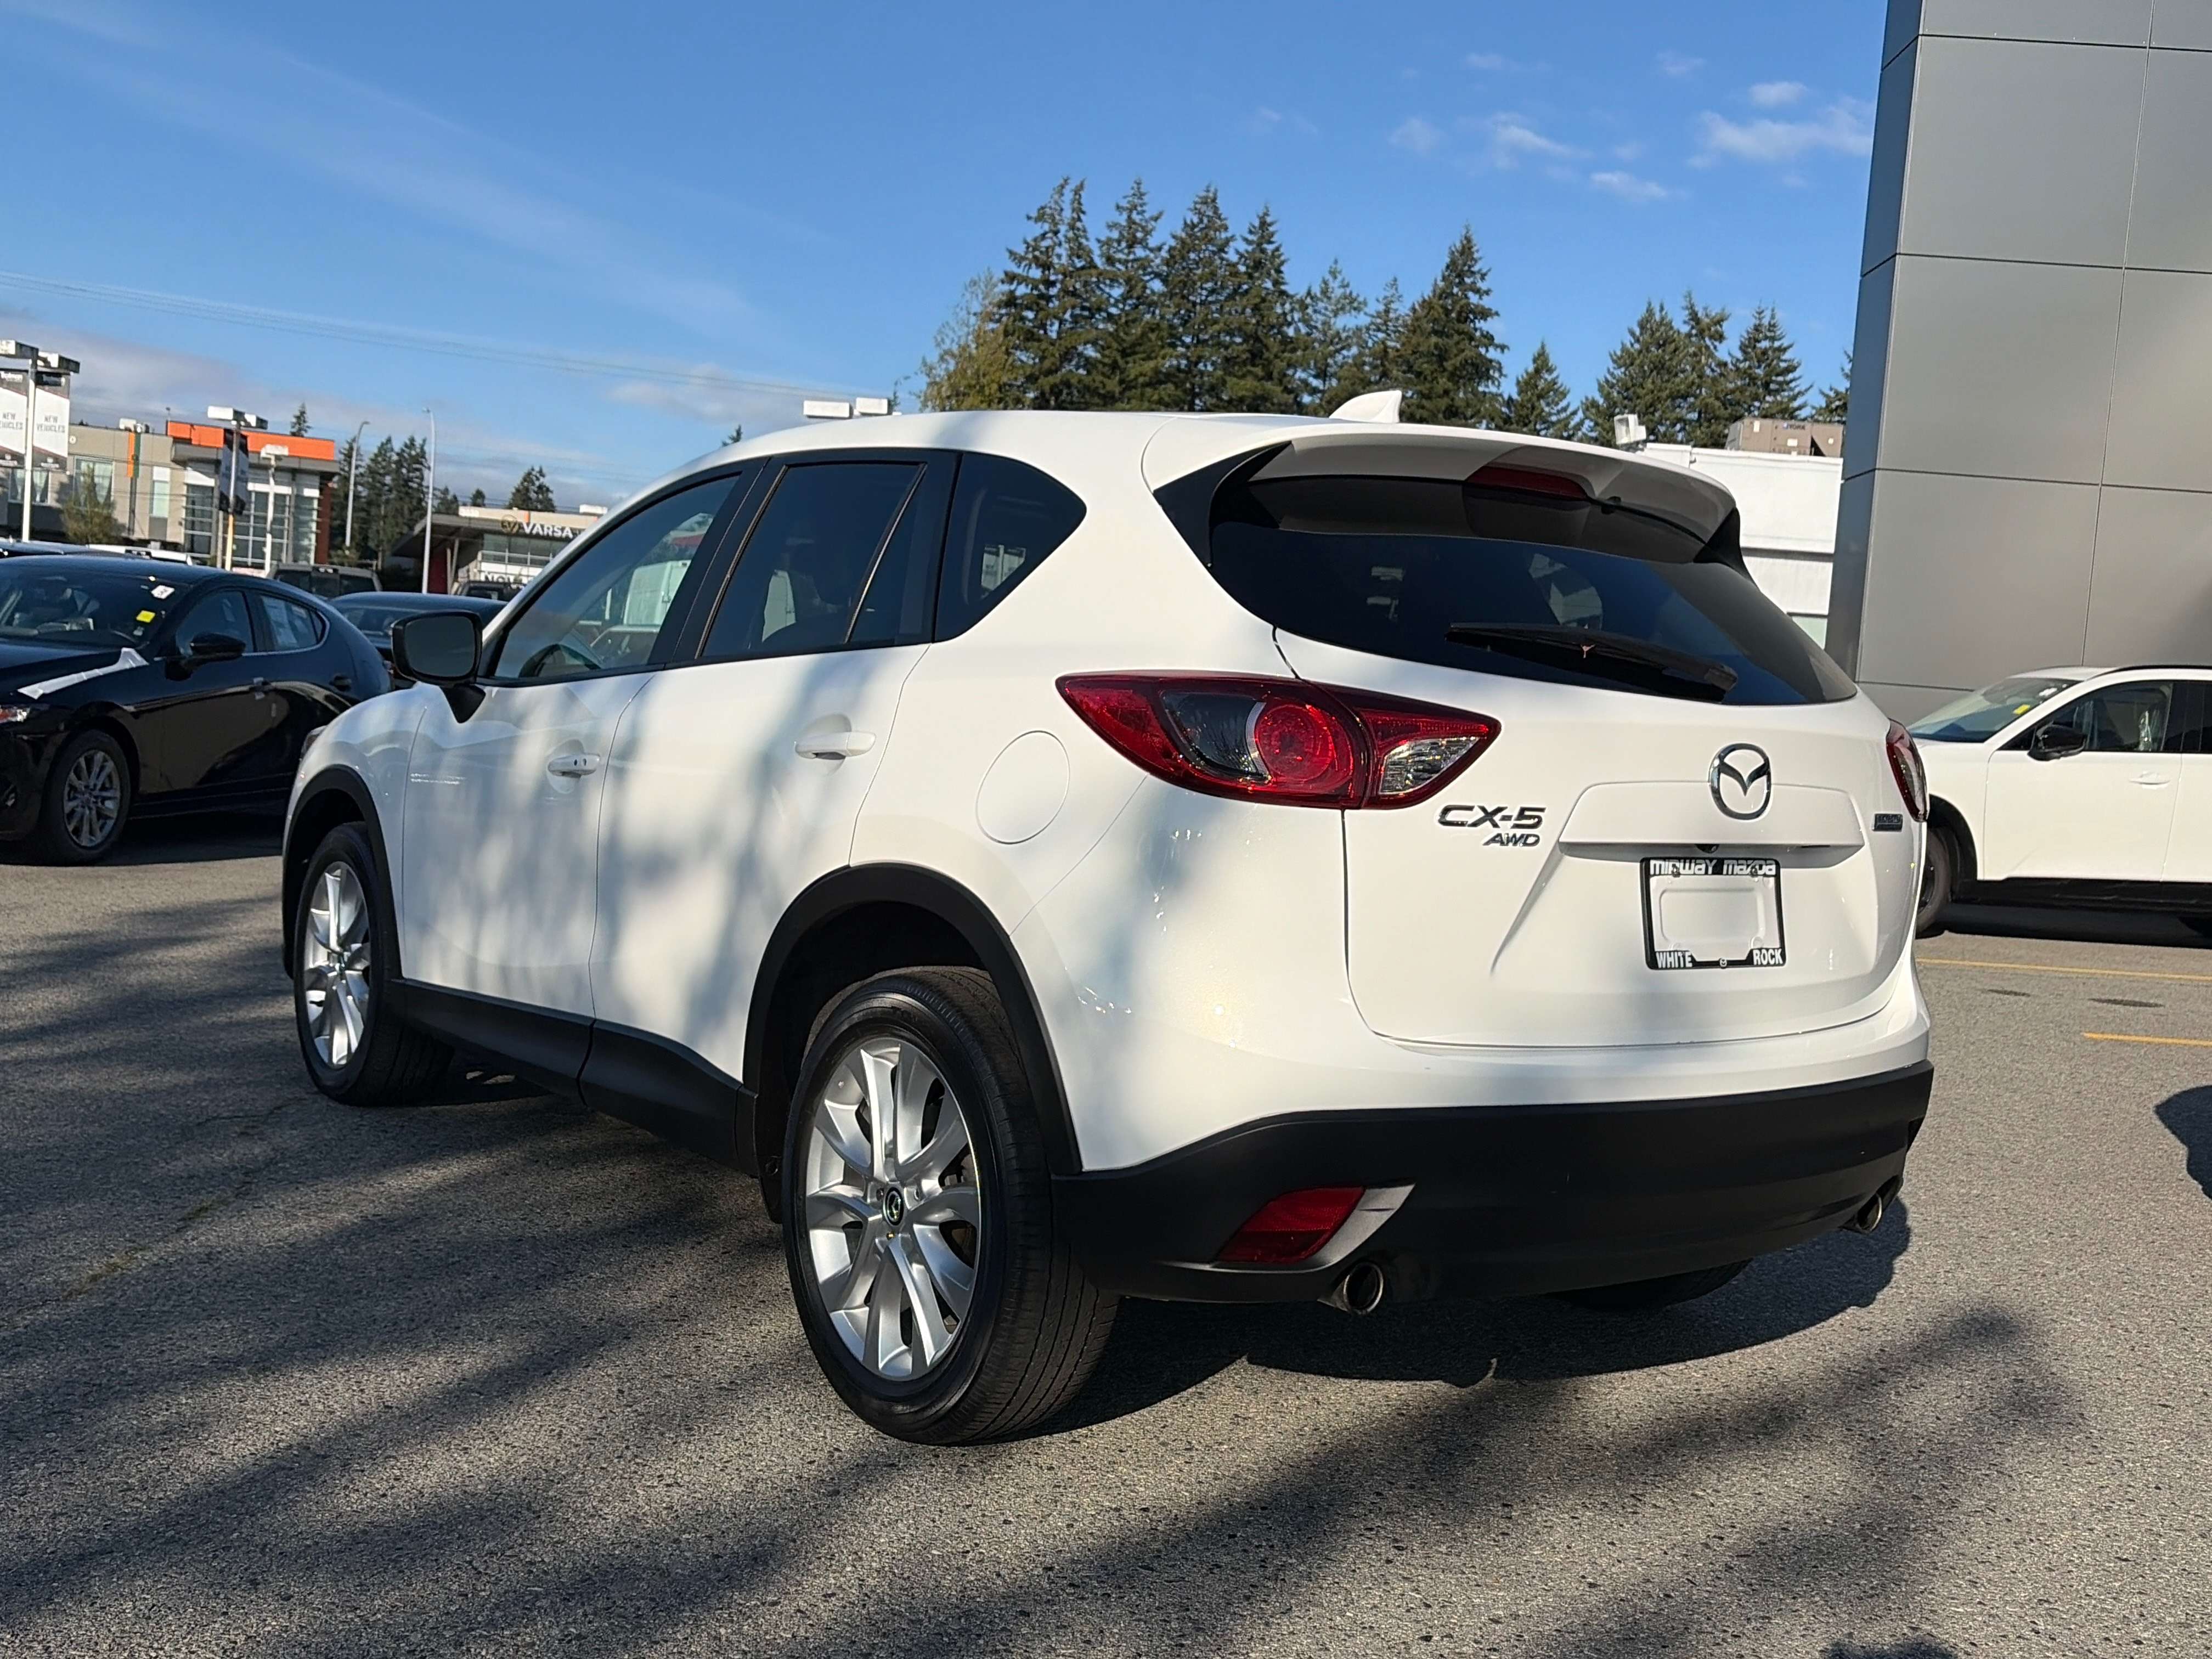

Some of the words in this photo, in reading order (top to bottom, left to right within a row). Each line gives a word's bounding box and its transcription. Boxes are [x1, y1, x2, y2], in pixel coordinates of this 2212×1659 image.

[0, 421, 24, 430] EHICLES
[44, 415, 58, 423] NEW
[36, 423, 66, 433] VEHICLES
[522, 522, 573, 539] VARSA
[1437, 805, 1546, 829] CX-5
[1482, 833, 1541, 847] AWD
[1656, 951, 1692, 968] WHITE
[1752, 949, 1784, 966] ROCK
